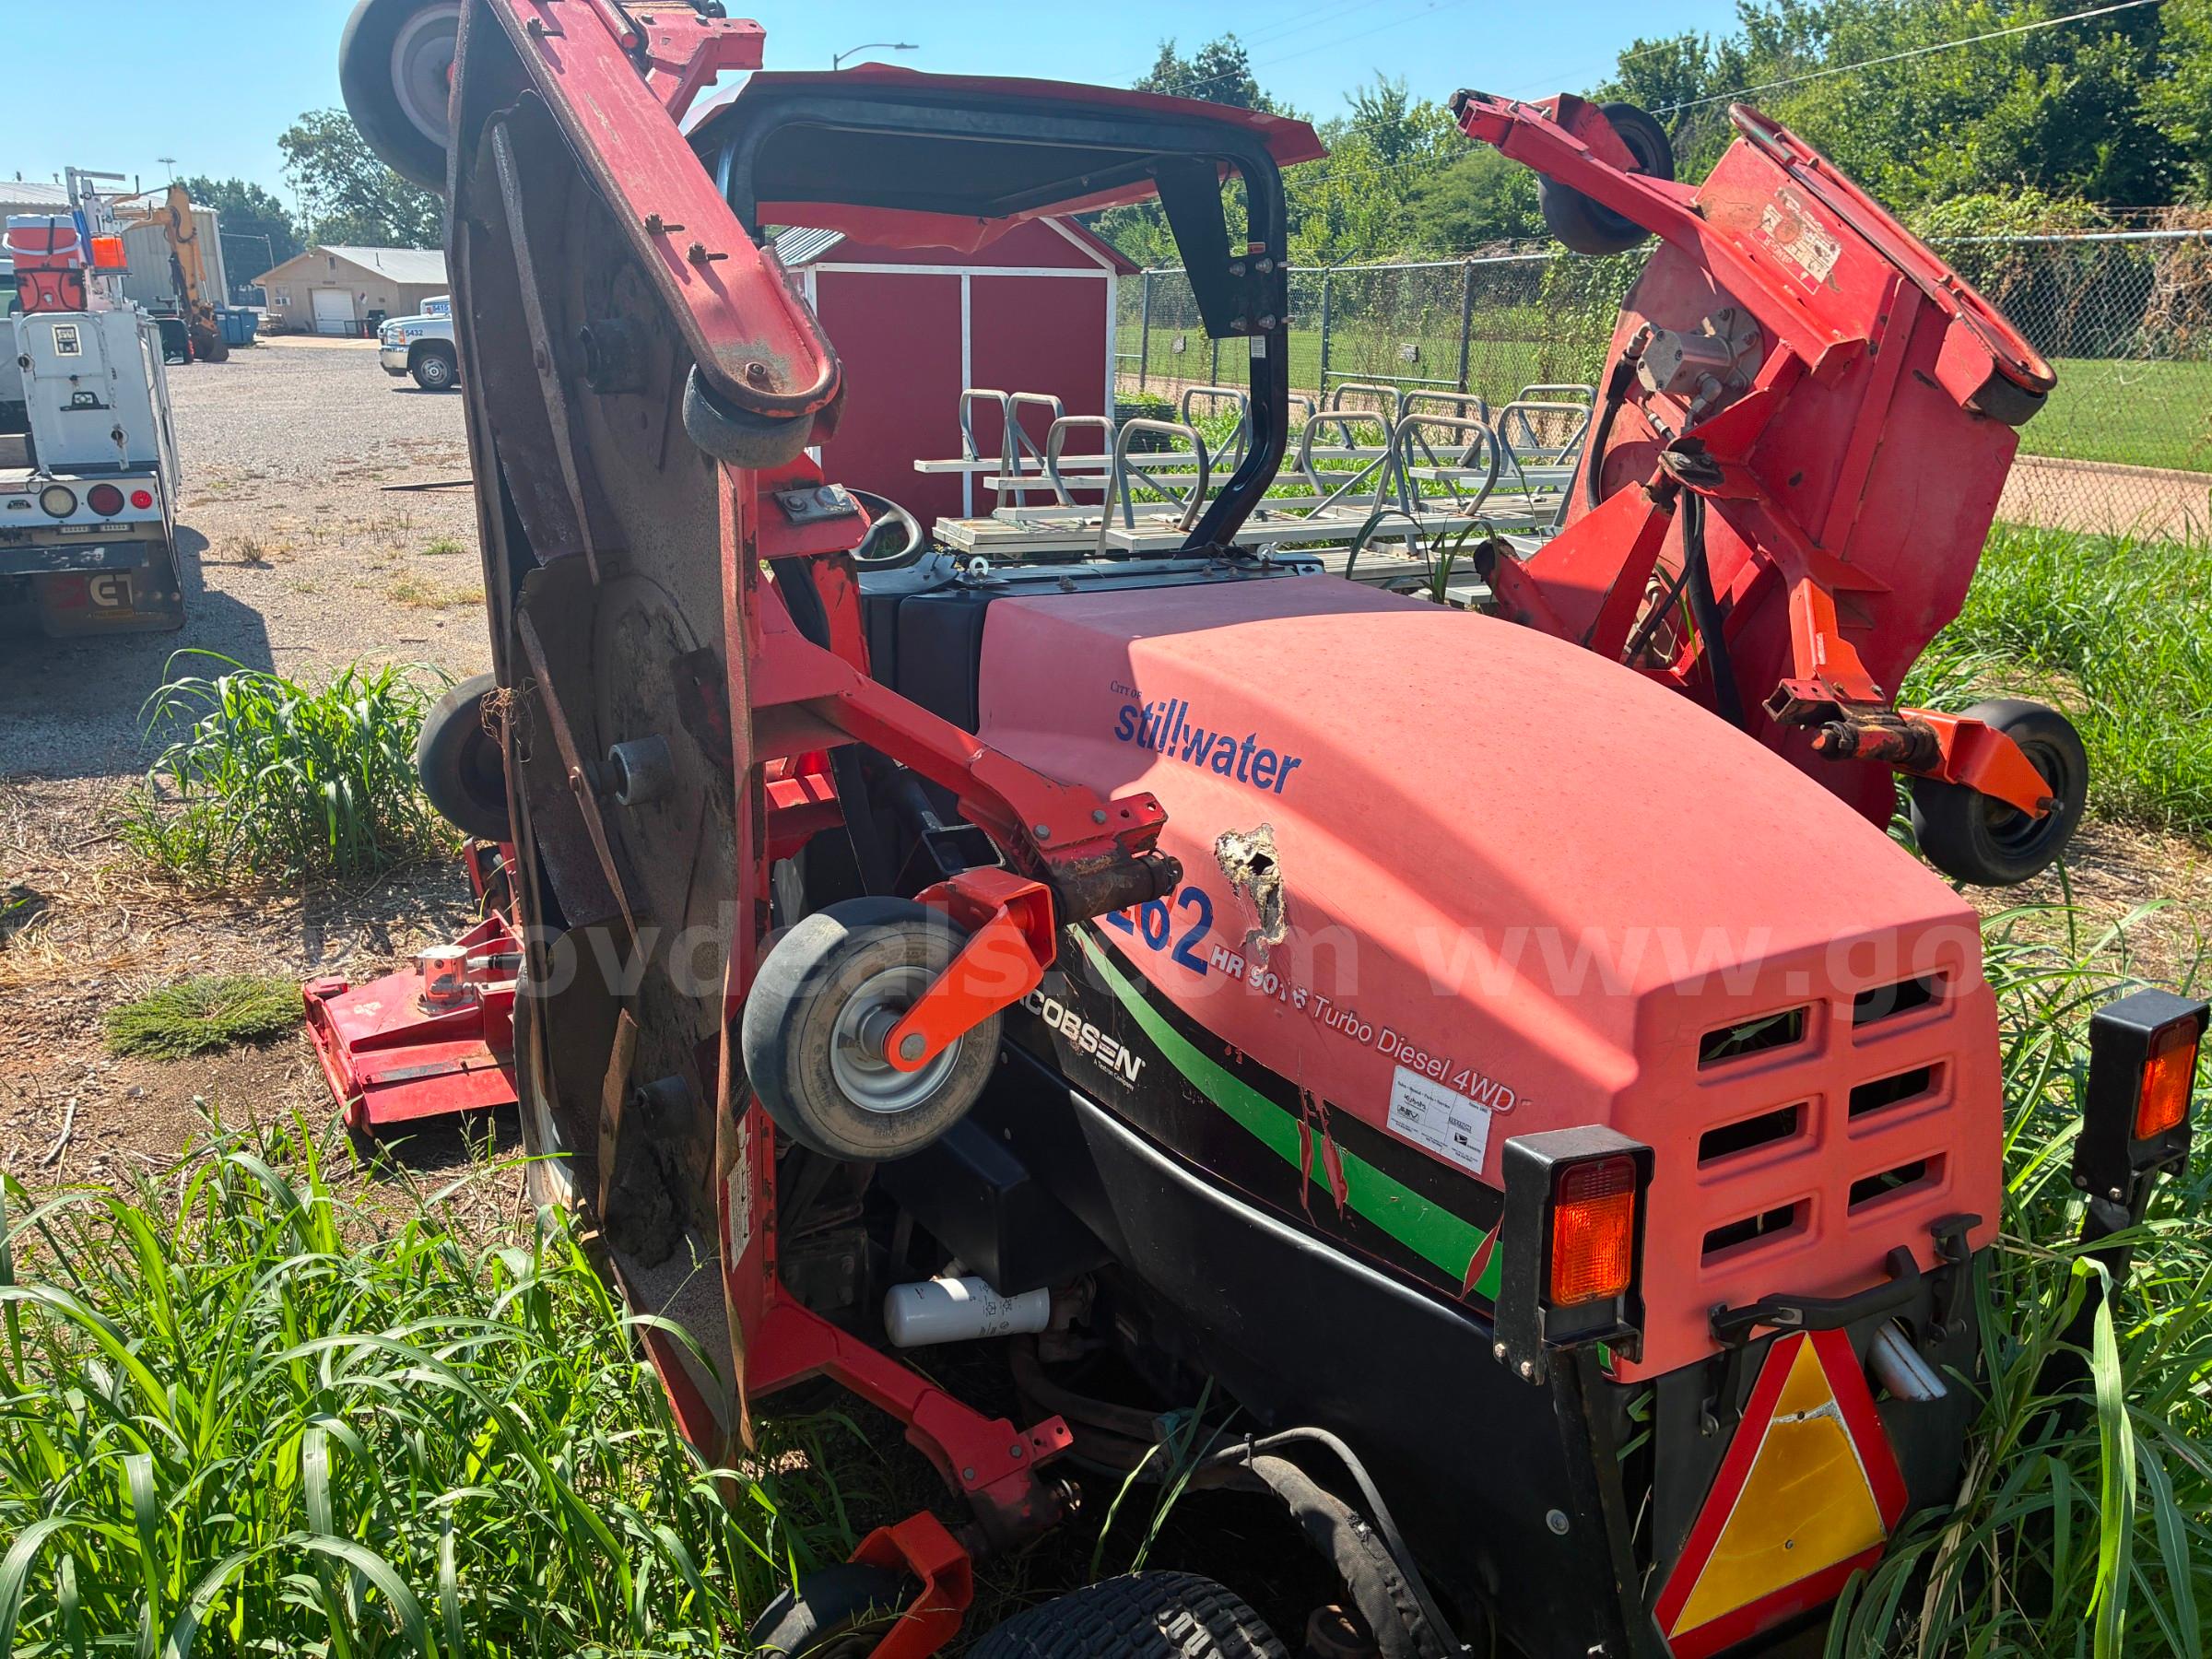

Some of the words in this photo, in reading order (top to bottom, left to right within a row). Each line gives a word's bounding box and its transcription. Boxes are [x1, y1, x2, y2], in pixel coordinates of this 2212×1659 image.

[1113, 699, 1301, 794] stillwater
[1019, 988, 1143, 1082] COBSEN
[1210, 944, 1245, 979] HR
[1313, 994, 1373, 1043] Turbo
[1377, 1027, 1453, 1081] Diesel
[1453, 1069, 1516, 1112] 4WD
